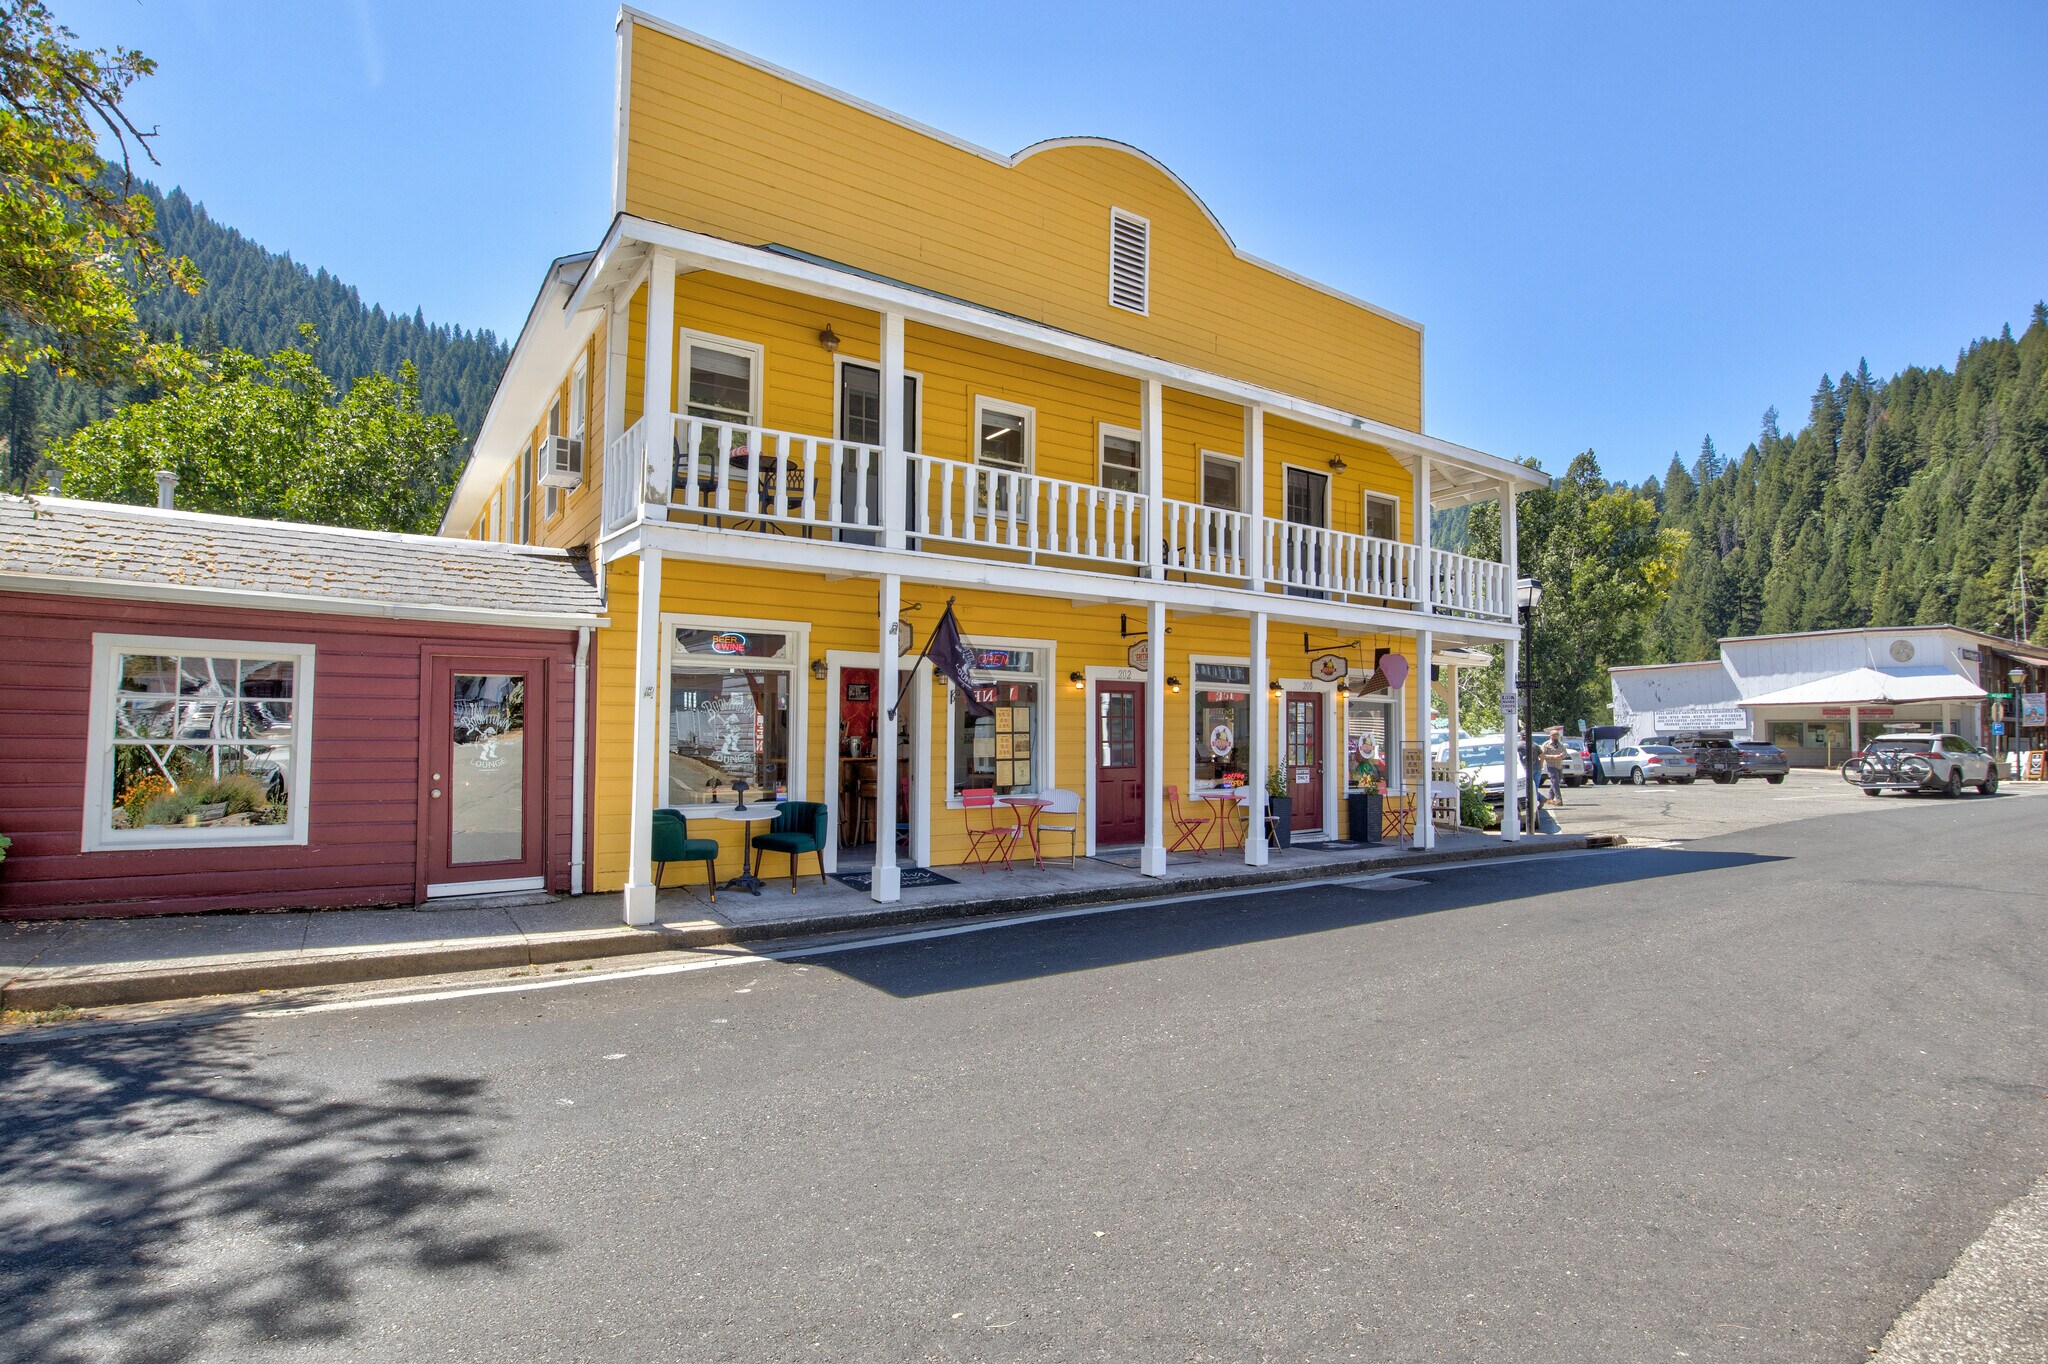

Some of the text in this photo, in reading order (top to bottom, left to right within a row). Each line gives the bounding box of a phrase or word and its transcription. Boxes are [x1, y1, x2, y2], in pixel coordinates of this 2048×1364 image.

[712, 636, 738, 644] BEER
[721, 644, 745, 652] WINE
[978, 654, 1009, 665] OPEN
[1118, 669, 1132, 679] 202
[1302, 681, 1313, 690] 200
[460, 713, 512, 736] BOOMTOWN
[470, 757, 507, 768] LOUNGE
[708, 751, 751, 764] LOUNGE
